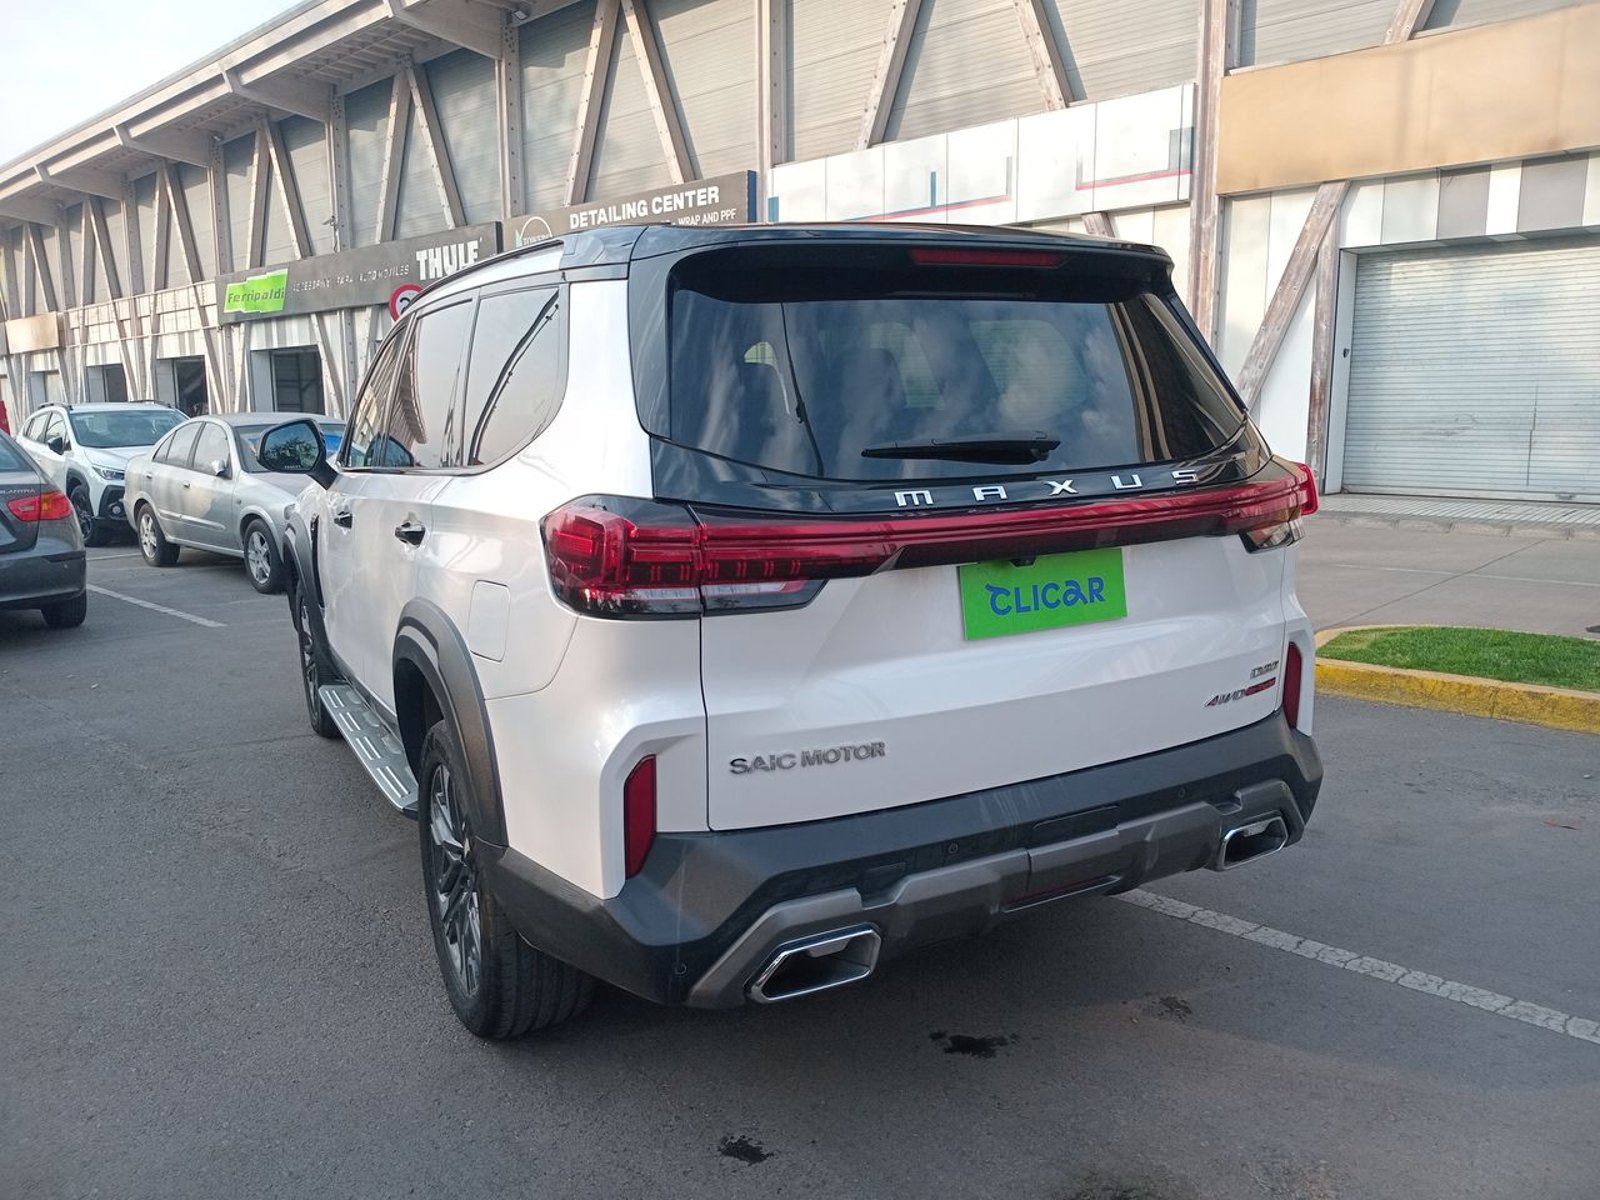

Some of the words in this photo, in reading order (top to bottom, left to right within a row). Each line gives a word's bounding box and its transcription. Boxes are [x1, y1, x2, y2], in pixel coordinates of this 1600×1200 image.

[569, 200, 648, 229] DETAILING
[651, 186, 720, 214] CENTER
[678, 214, 701, 226] WRAP
[702, 211, 720, 224] AND
[720, 208, 737, 221] PPF
[416, 241, 478, 280] THULE
[227, 287, 284, 303] Ferripaldi
[894, 468, 1199, 507] MAXUS
[729, 751, 797, 776] SAIC
[801, 740, 887, 768] MOTOR
